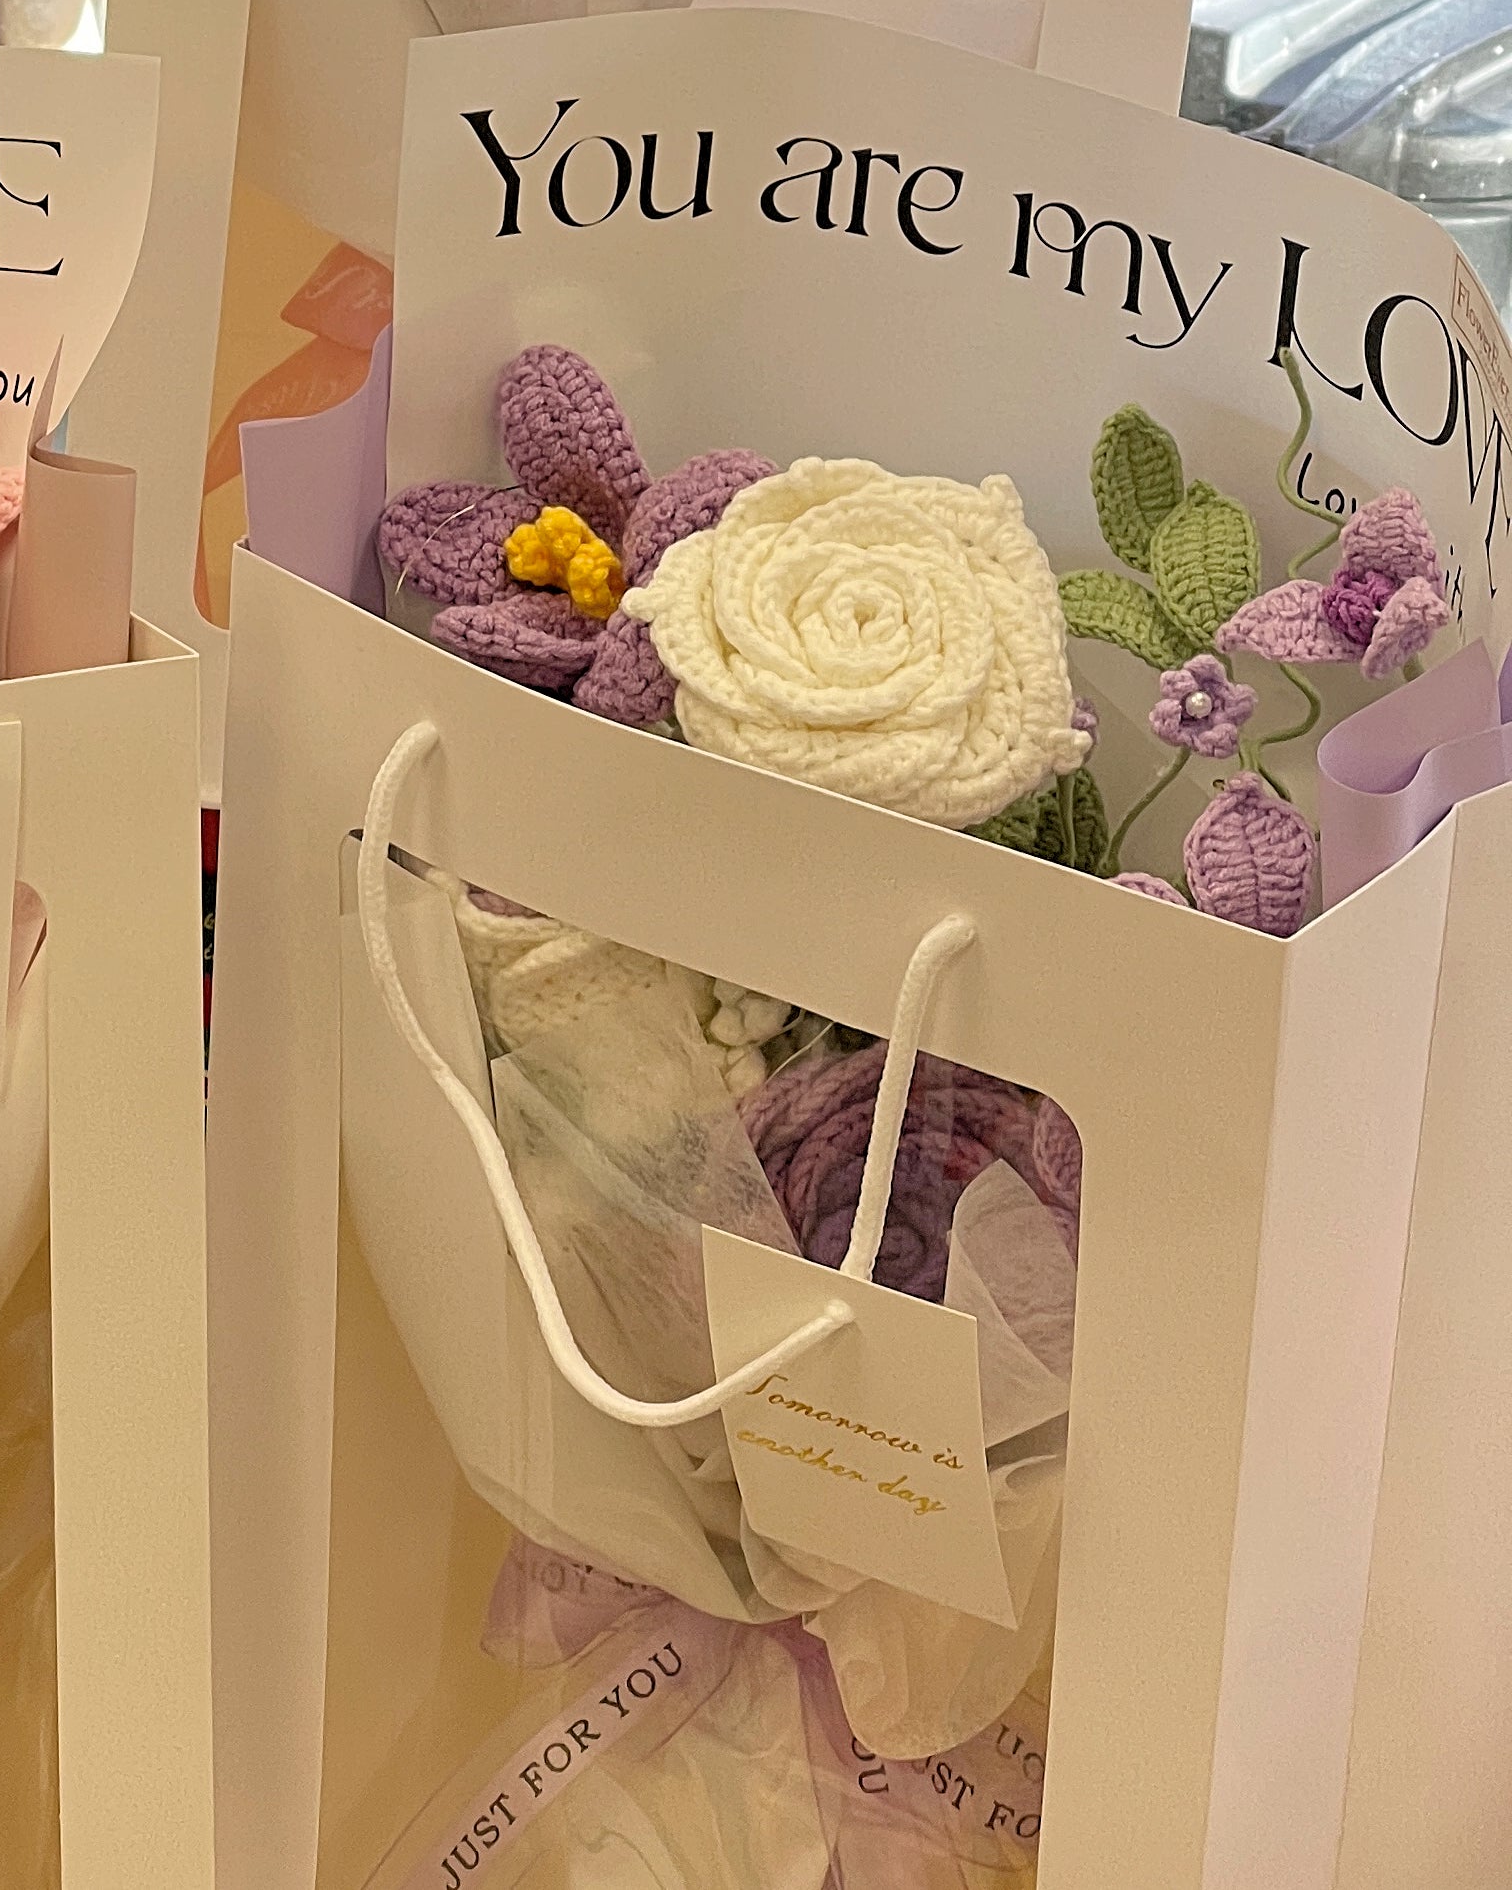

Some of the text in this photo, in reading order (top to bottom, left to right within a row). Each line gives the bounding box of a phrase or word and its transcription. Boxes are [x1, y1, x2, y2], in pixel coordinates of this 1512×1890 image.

[459, 97, 714, 239] You
[759, 134, 966, 256] are
[1007, 190, 1233, 350] my
[737, 1429, 948, 1516] another day
[932, 1448, 965, 1470] is
[441, 1642, 683, 1890] JUST FOR YOU
